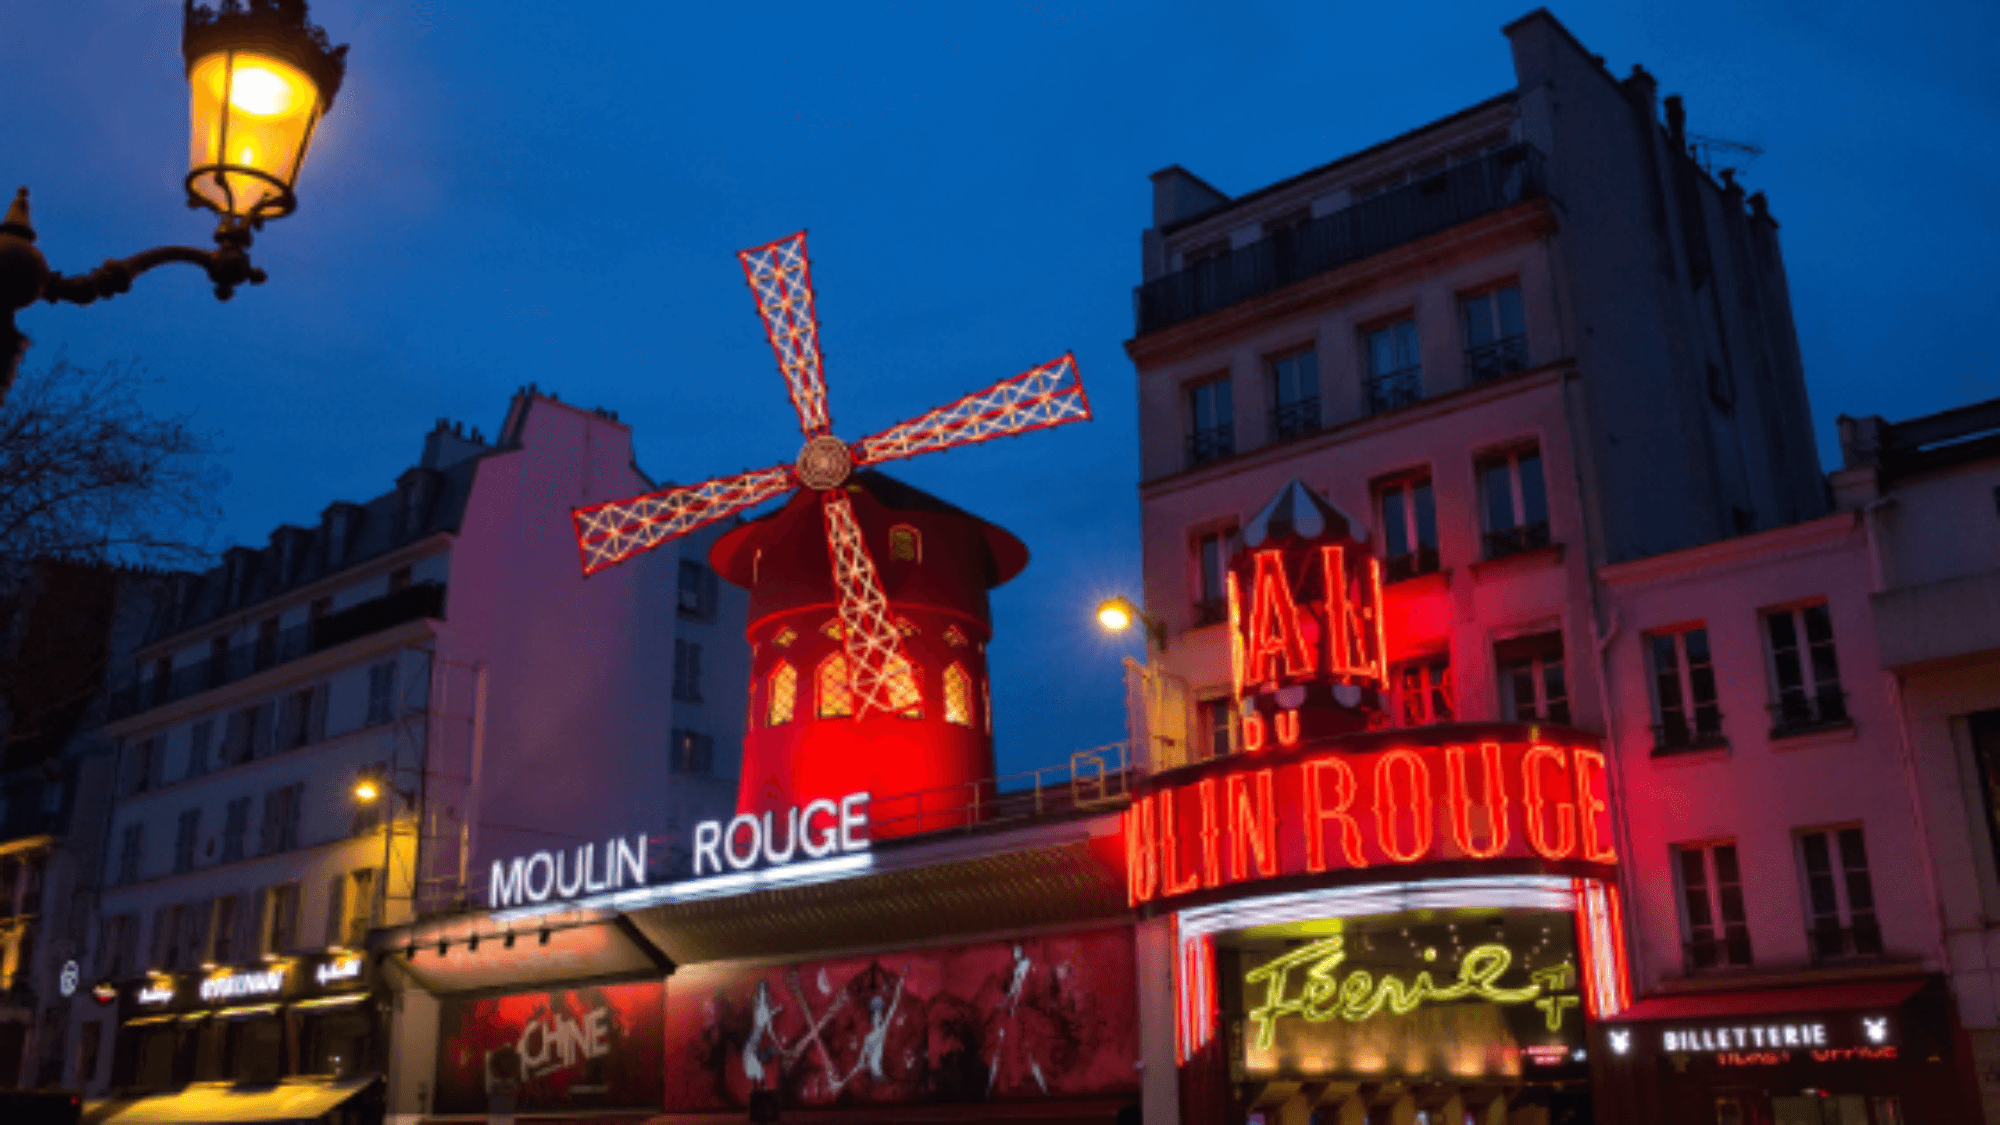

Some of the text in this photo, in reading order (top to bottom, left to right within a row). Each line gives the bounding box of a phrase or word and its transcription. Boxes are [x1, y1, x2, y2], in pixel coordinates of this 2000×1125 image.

[1242, 709, 1299, 751] DU
[1301, 742, 1618, 874] ROUGE
[488, 791, 871, 908] MOULIN ROUGE
[1663, 1024, 1826, 1051] BILLETTERIE
